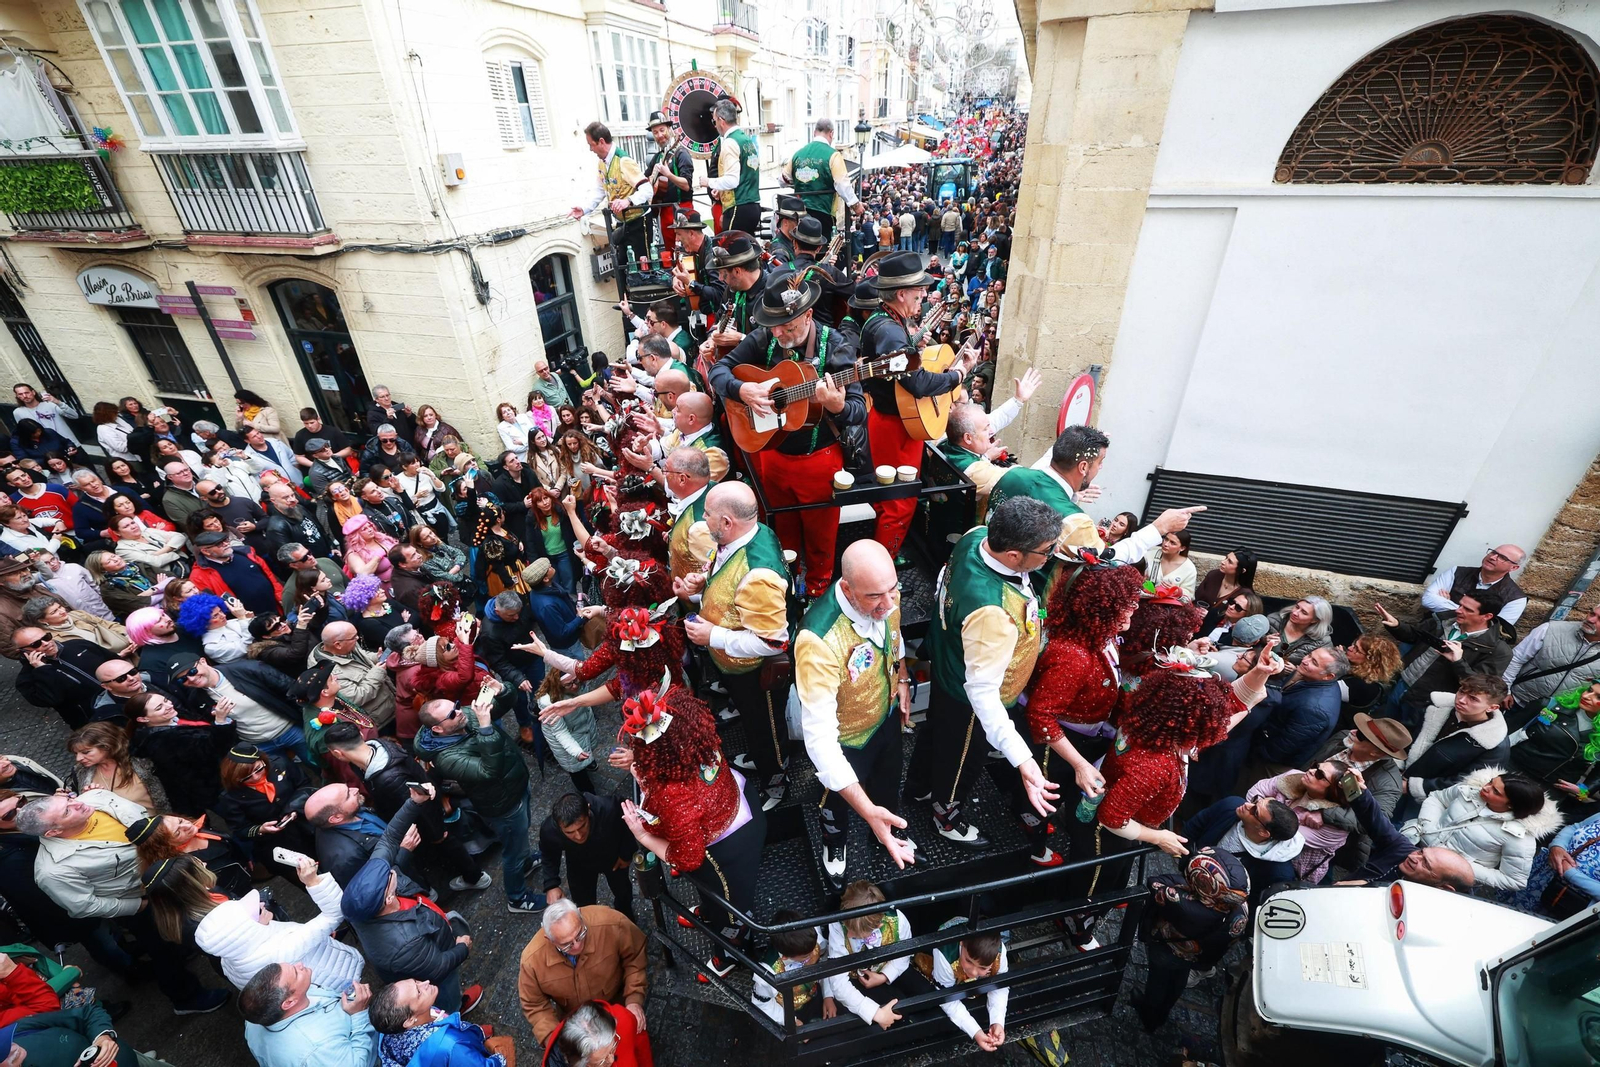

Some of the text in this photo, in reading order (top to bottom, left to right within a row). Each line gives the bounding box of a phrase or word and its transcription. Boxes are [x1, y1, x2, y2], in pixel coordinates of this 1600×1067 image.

[83, 274, 109, 297] Mesón
[105, 284, 125, 304] Las
[121, 282, 153, 302] Brisas
[1264, 905, 1301, 929] 40
